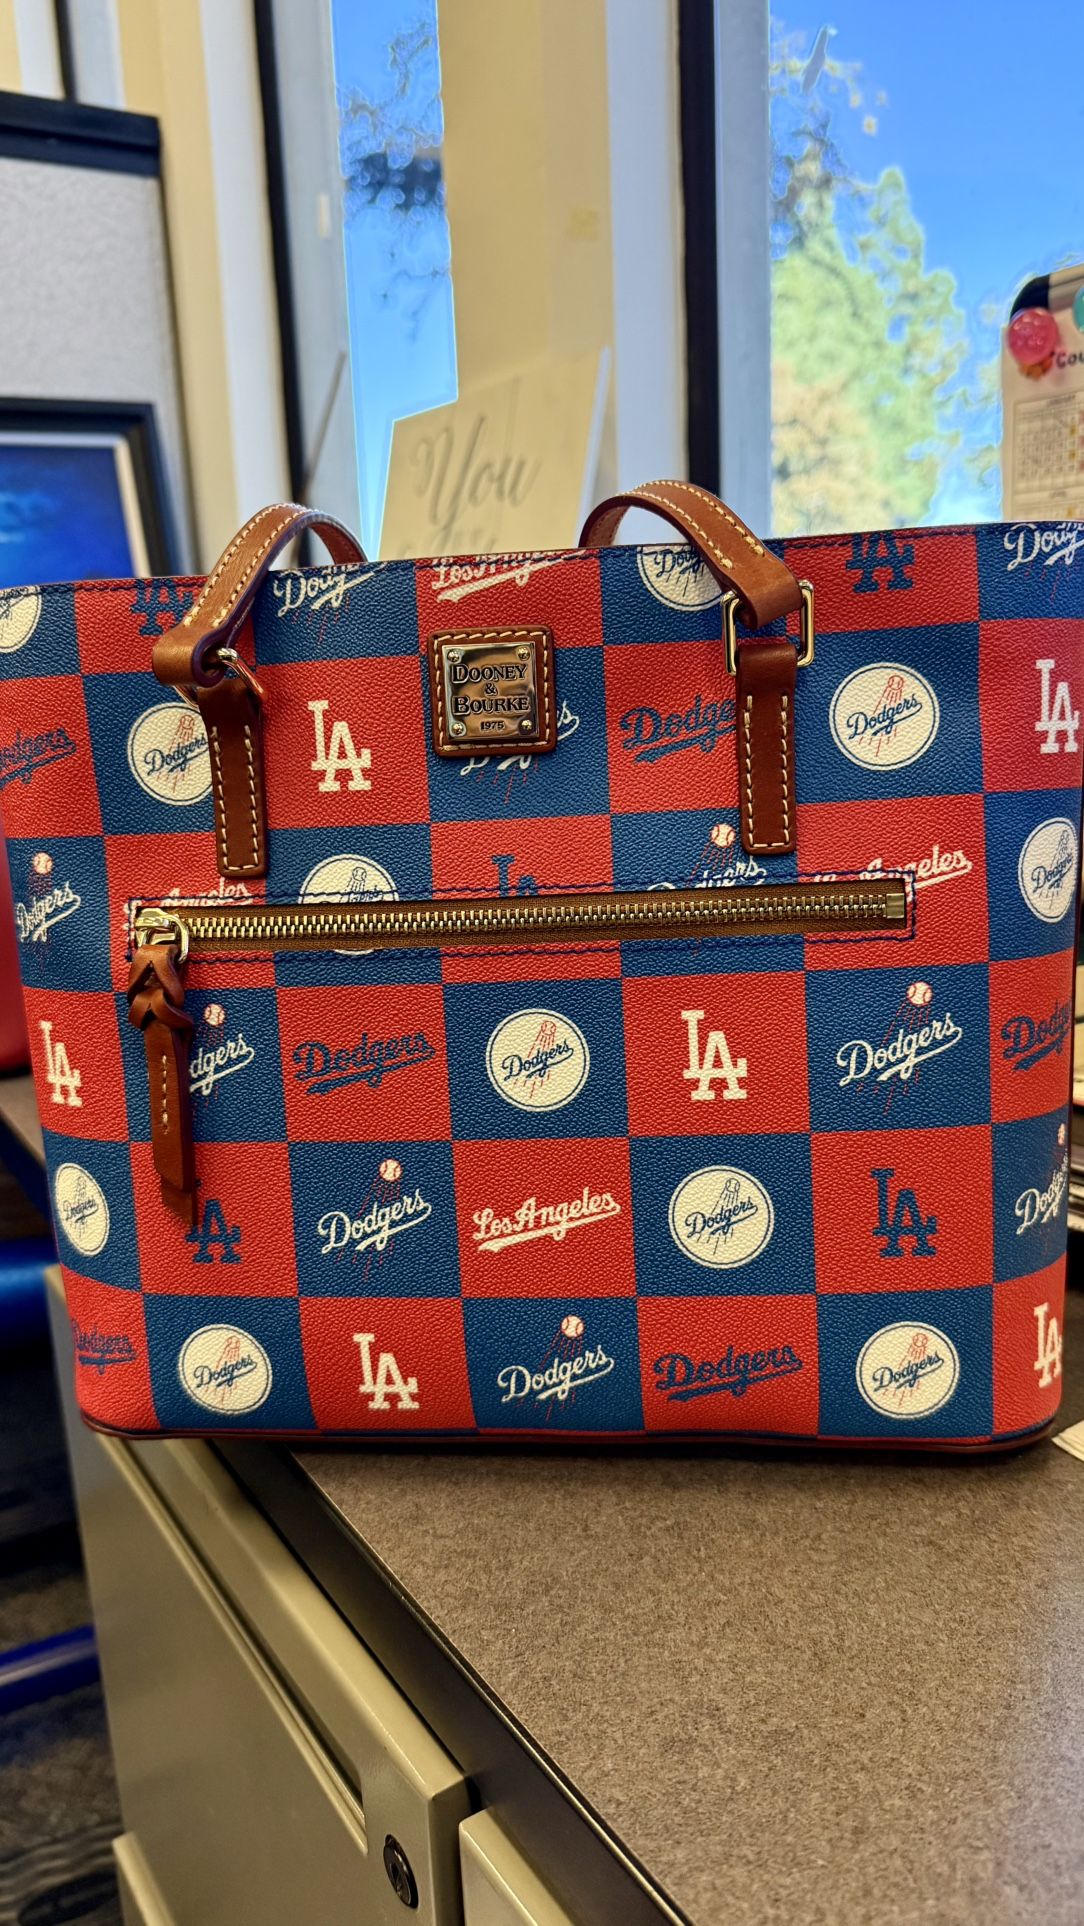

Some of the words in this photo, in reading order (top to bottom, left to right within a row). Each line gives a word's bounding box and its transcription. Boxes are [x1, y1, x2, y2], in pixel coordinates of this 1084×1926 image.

[484, 682, 498, 697] &
[846, 693, 923, 740] Dodgers
[1035, 659, 1080, 754] LA
[308, 700, 372, 792] LA
[480, 721, 505, 731] 1975
[619, 694, 737, 764] Dodge
[39, 1020, 83, 1107] LA
[189, 1033, 255, 1096] dgers
[294, 1031, 437, 1096] Dodgers
[502, 1038, 574, 1081] Dodgers
[681, 1009, 748, 1101] LA
[836, 1012, 963, 1087] Dodgers
[185, 1199, 243, 1264] A
[318, 1188, 432, 1254] Dodgers
[685, 1198, 758, 1238] Dodgers
[871, 1168, 938, 1258] LA
[193, 1354, 258, 1388] Dodgers
[352, 1333, 420, 1410] LA
[497, 1345, 615, 1402] Dodgers
[653, 1343, 802, 1402] Dodgers
[872, 1352, 944, 1393] Dodgers
